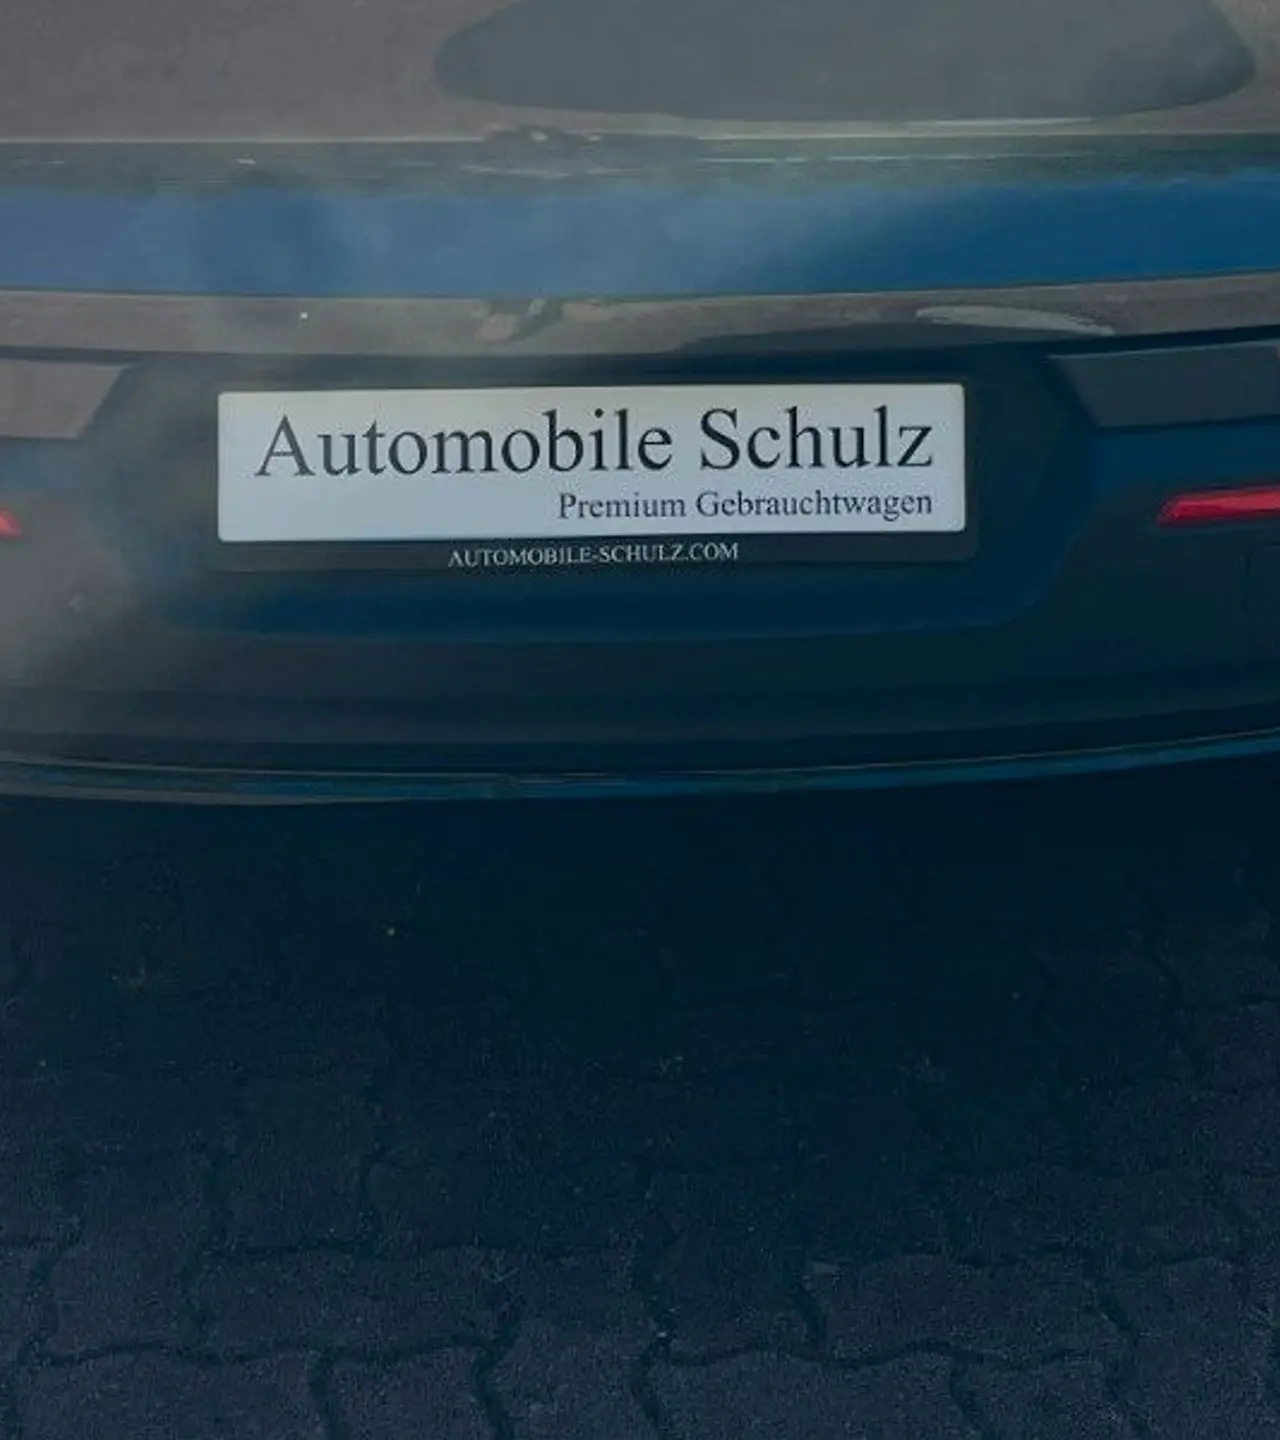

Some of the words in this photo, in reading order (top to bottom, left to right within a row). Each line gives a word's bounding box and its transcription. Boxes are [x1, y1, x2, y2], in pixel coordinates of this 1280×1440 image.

[254, 407, 674, 476] Automobile
[699, 404, 934, 471] Schulz
[558, 491, 687, 520] Premium
[695, 488, 934, 522] Gebrauchtwagen
[447, 541, 740, 569] AUTOMOBILE-SCHULZ.COM
